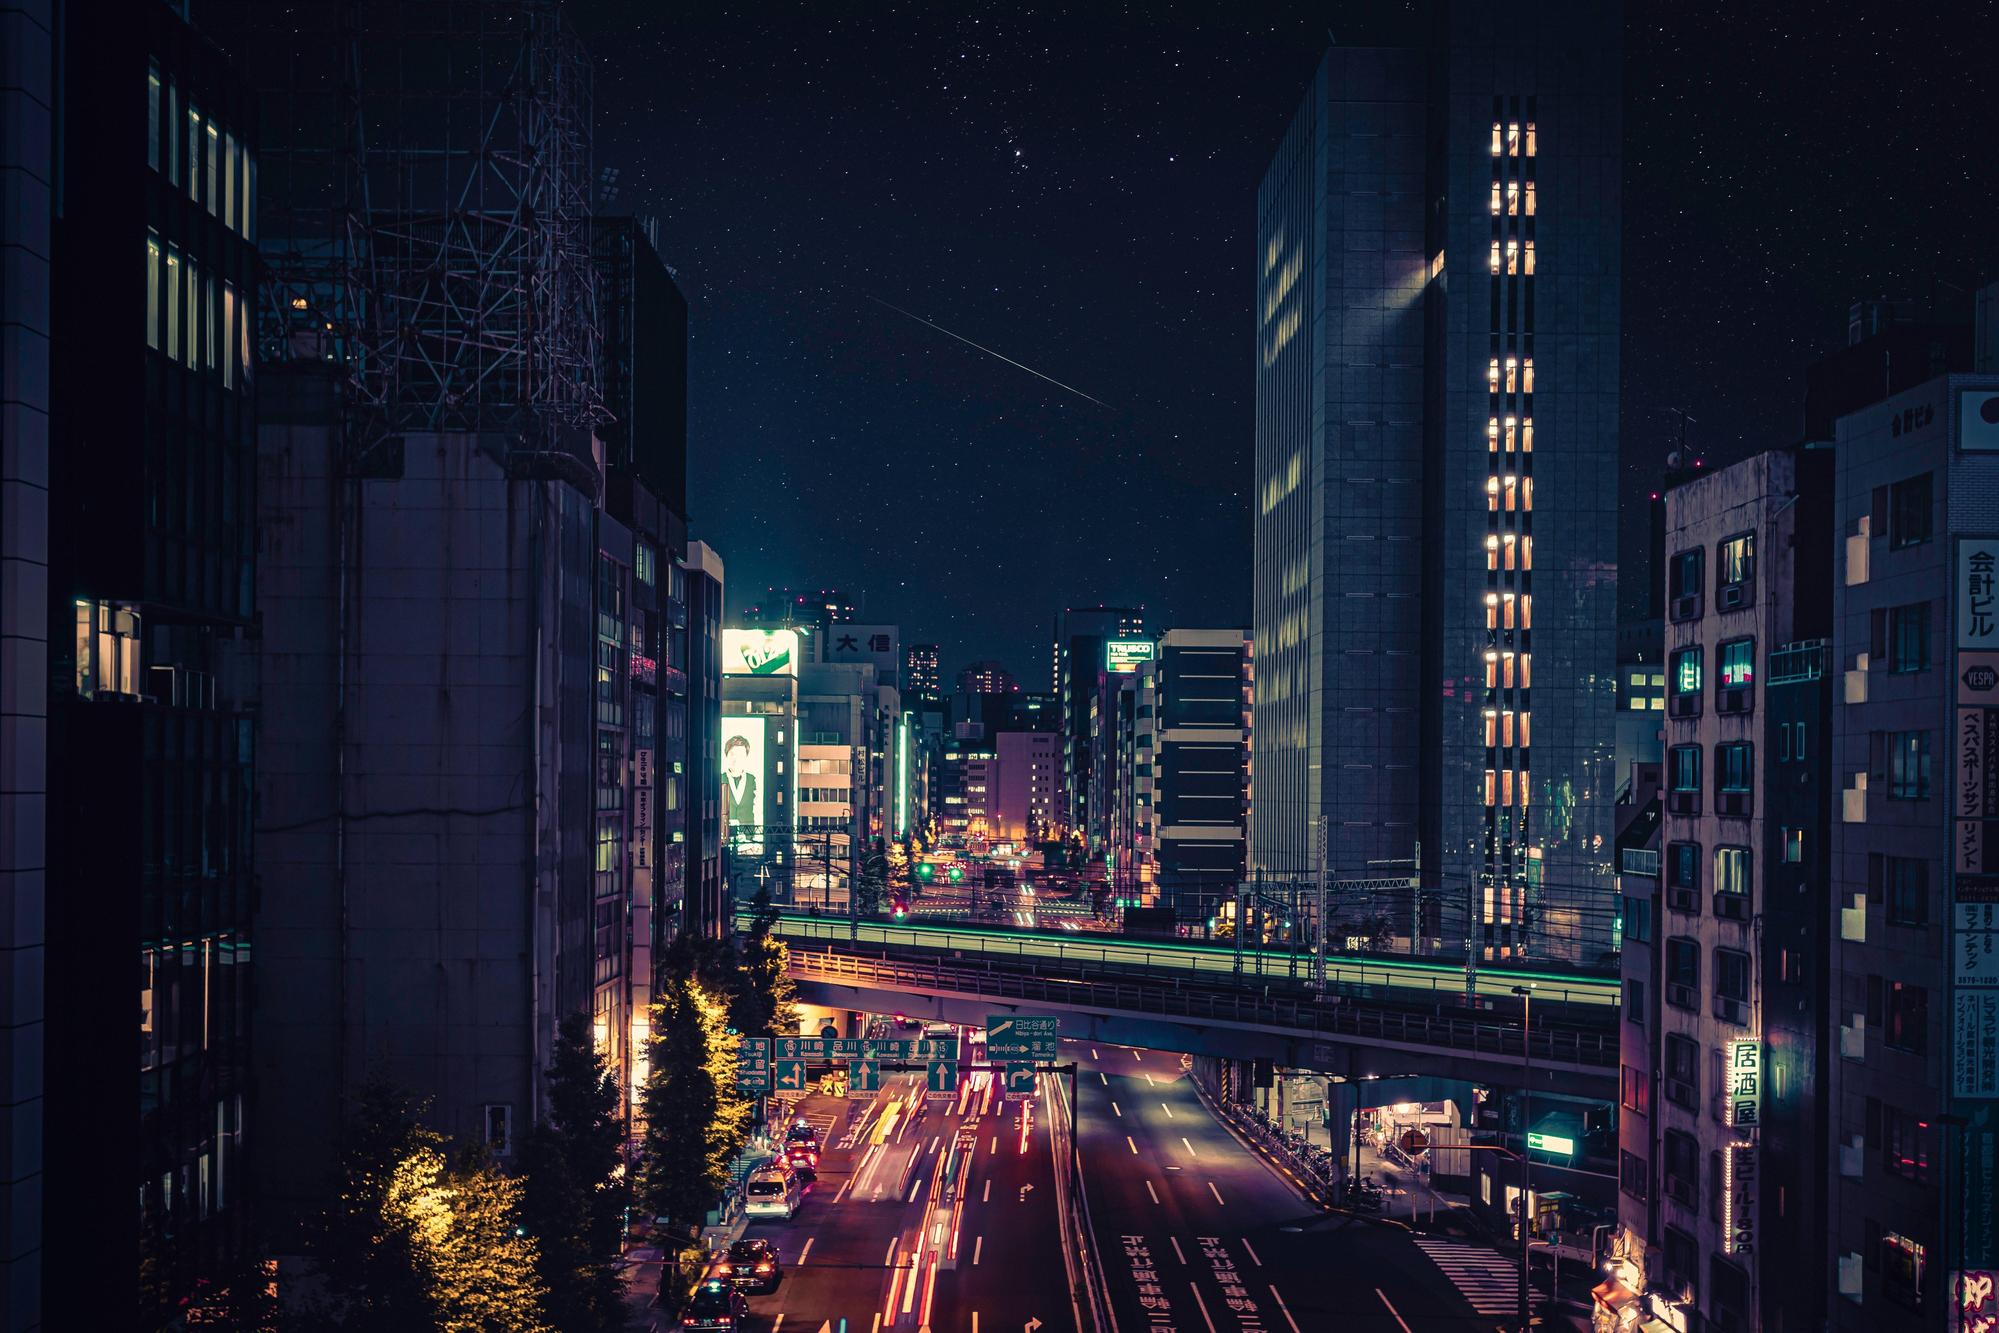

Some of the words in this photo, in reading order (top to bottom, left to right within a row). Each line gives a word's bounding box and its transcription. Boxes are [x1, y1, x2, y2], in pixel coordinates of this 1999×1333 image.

[1968, 550, 1995, 637] 会計ビル
[836, 634, 890, 653] 大信
[1968, 671, 1994, 686] VESPA
[1015, 1019, 1055, 1031] 日比谷通り
[801, 1041, 824, 1051] 川崎
[833, 1041, 857, 1051] 品川
[877, 1041, 899, 1051] 川崎
[1734, 1044, 1756, 1125] 居酒屋
